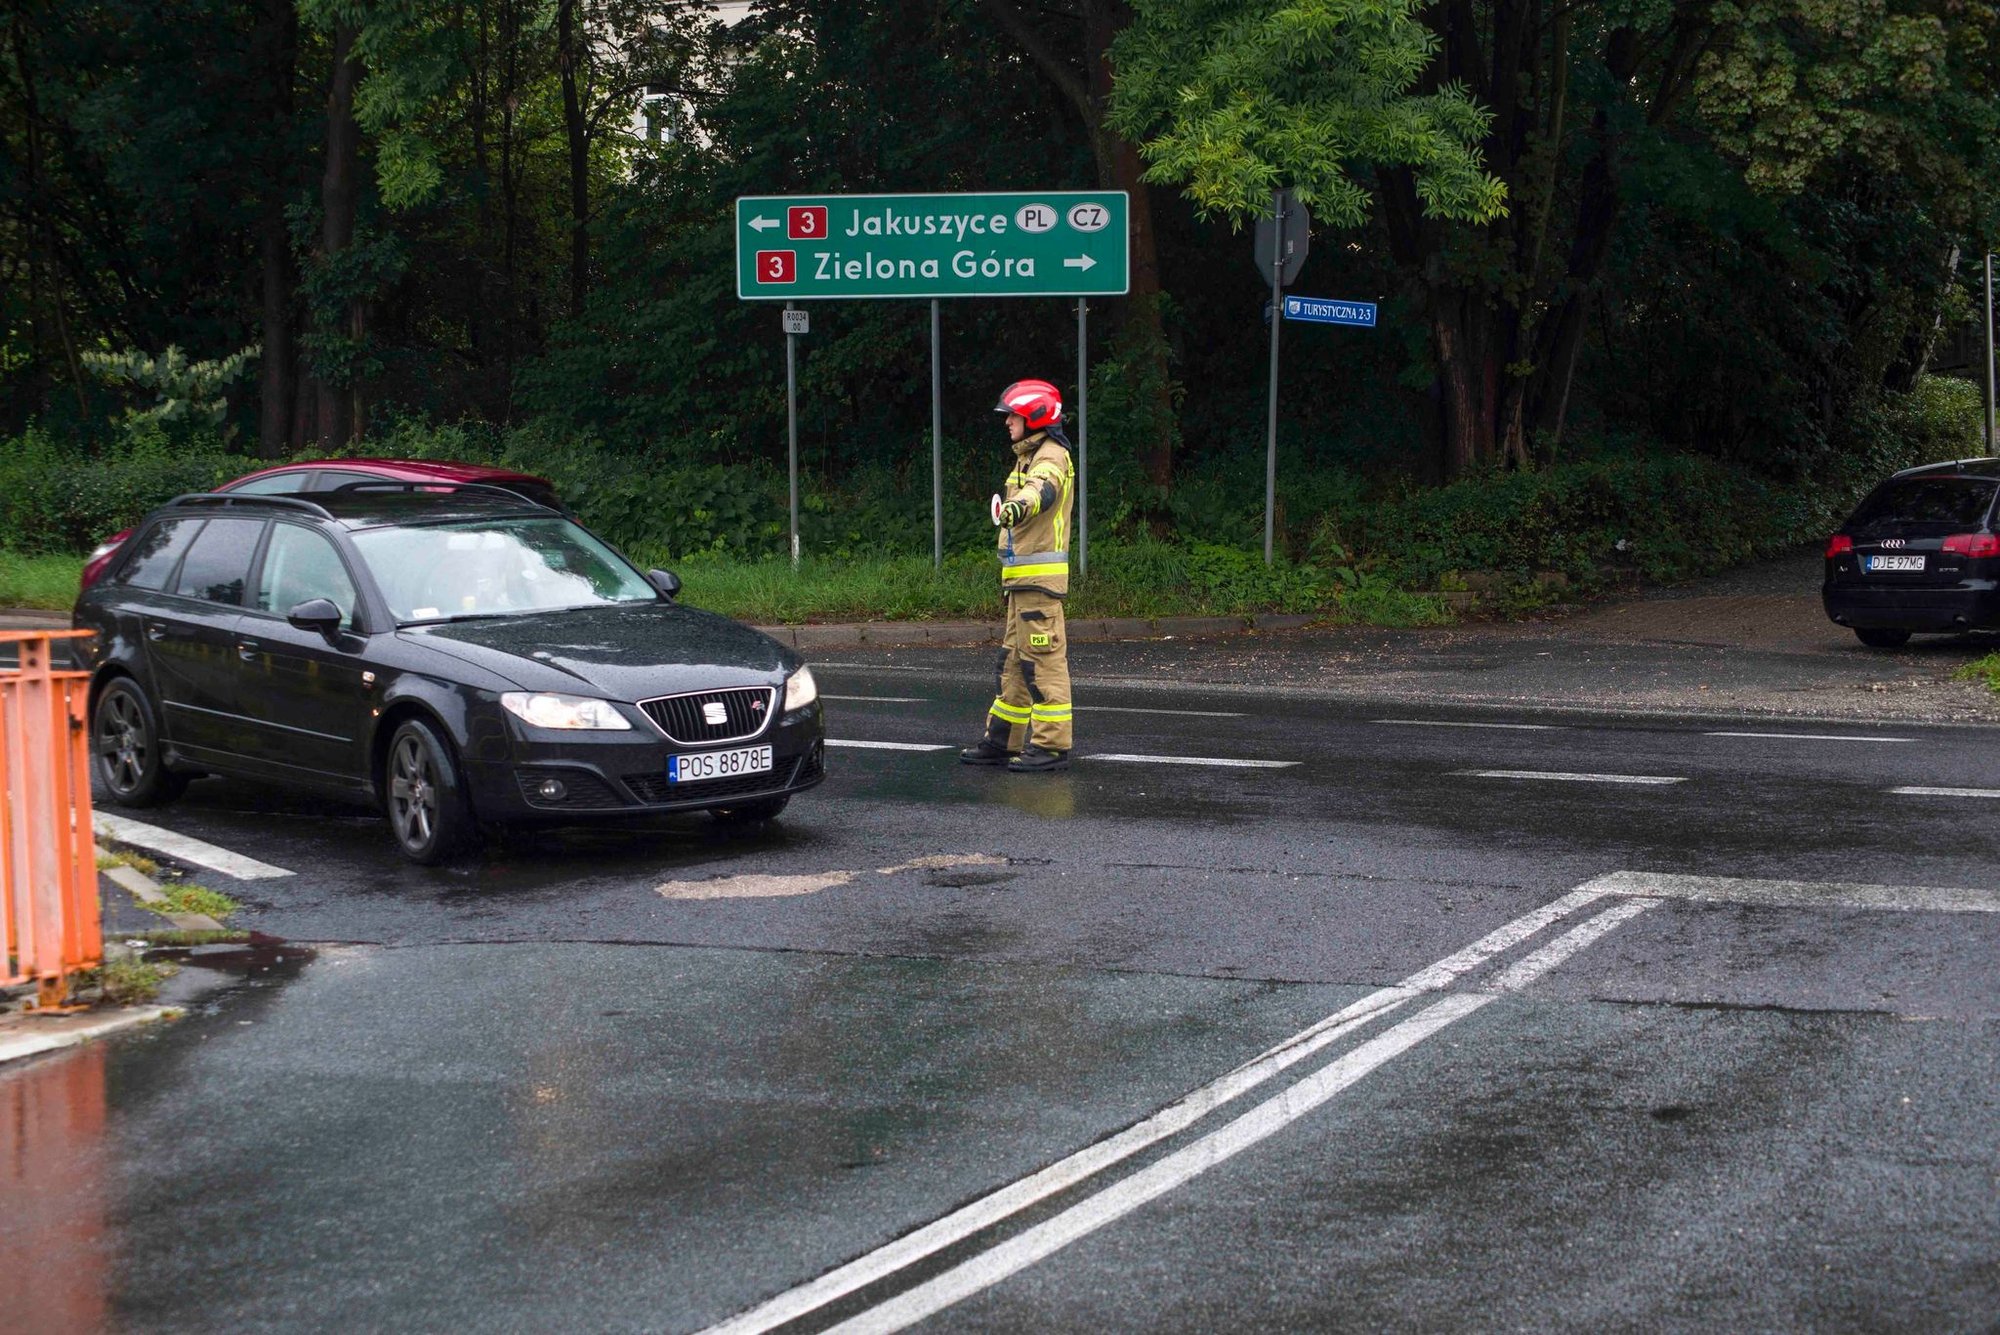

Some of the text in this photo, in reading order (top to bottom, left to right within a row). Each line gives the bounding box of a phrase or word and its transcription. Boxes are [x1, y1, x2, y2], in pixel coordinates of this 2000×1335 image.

[800, 207, 1102, 242] 3 Jakuszyce PL CZ
[768, 249, 1035, 280] 3 Zielona Góra
[1303, 303, 1357, 319] TURYSTYCZNA
[1873, 556, 1923, 569] DJE 97MG
[679, 754, 713, 779] POS
[719, 747, 771, 772] 8878E
